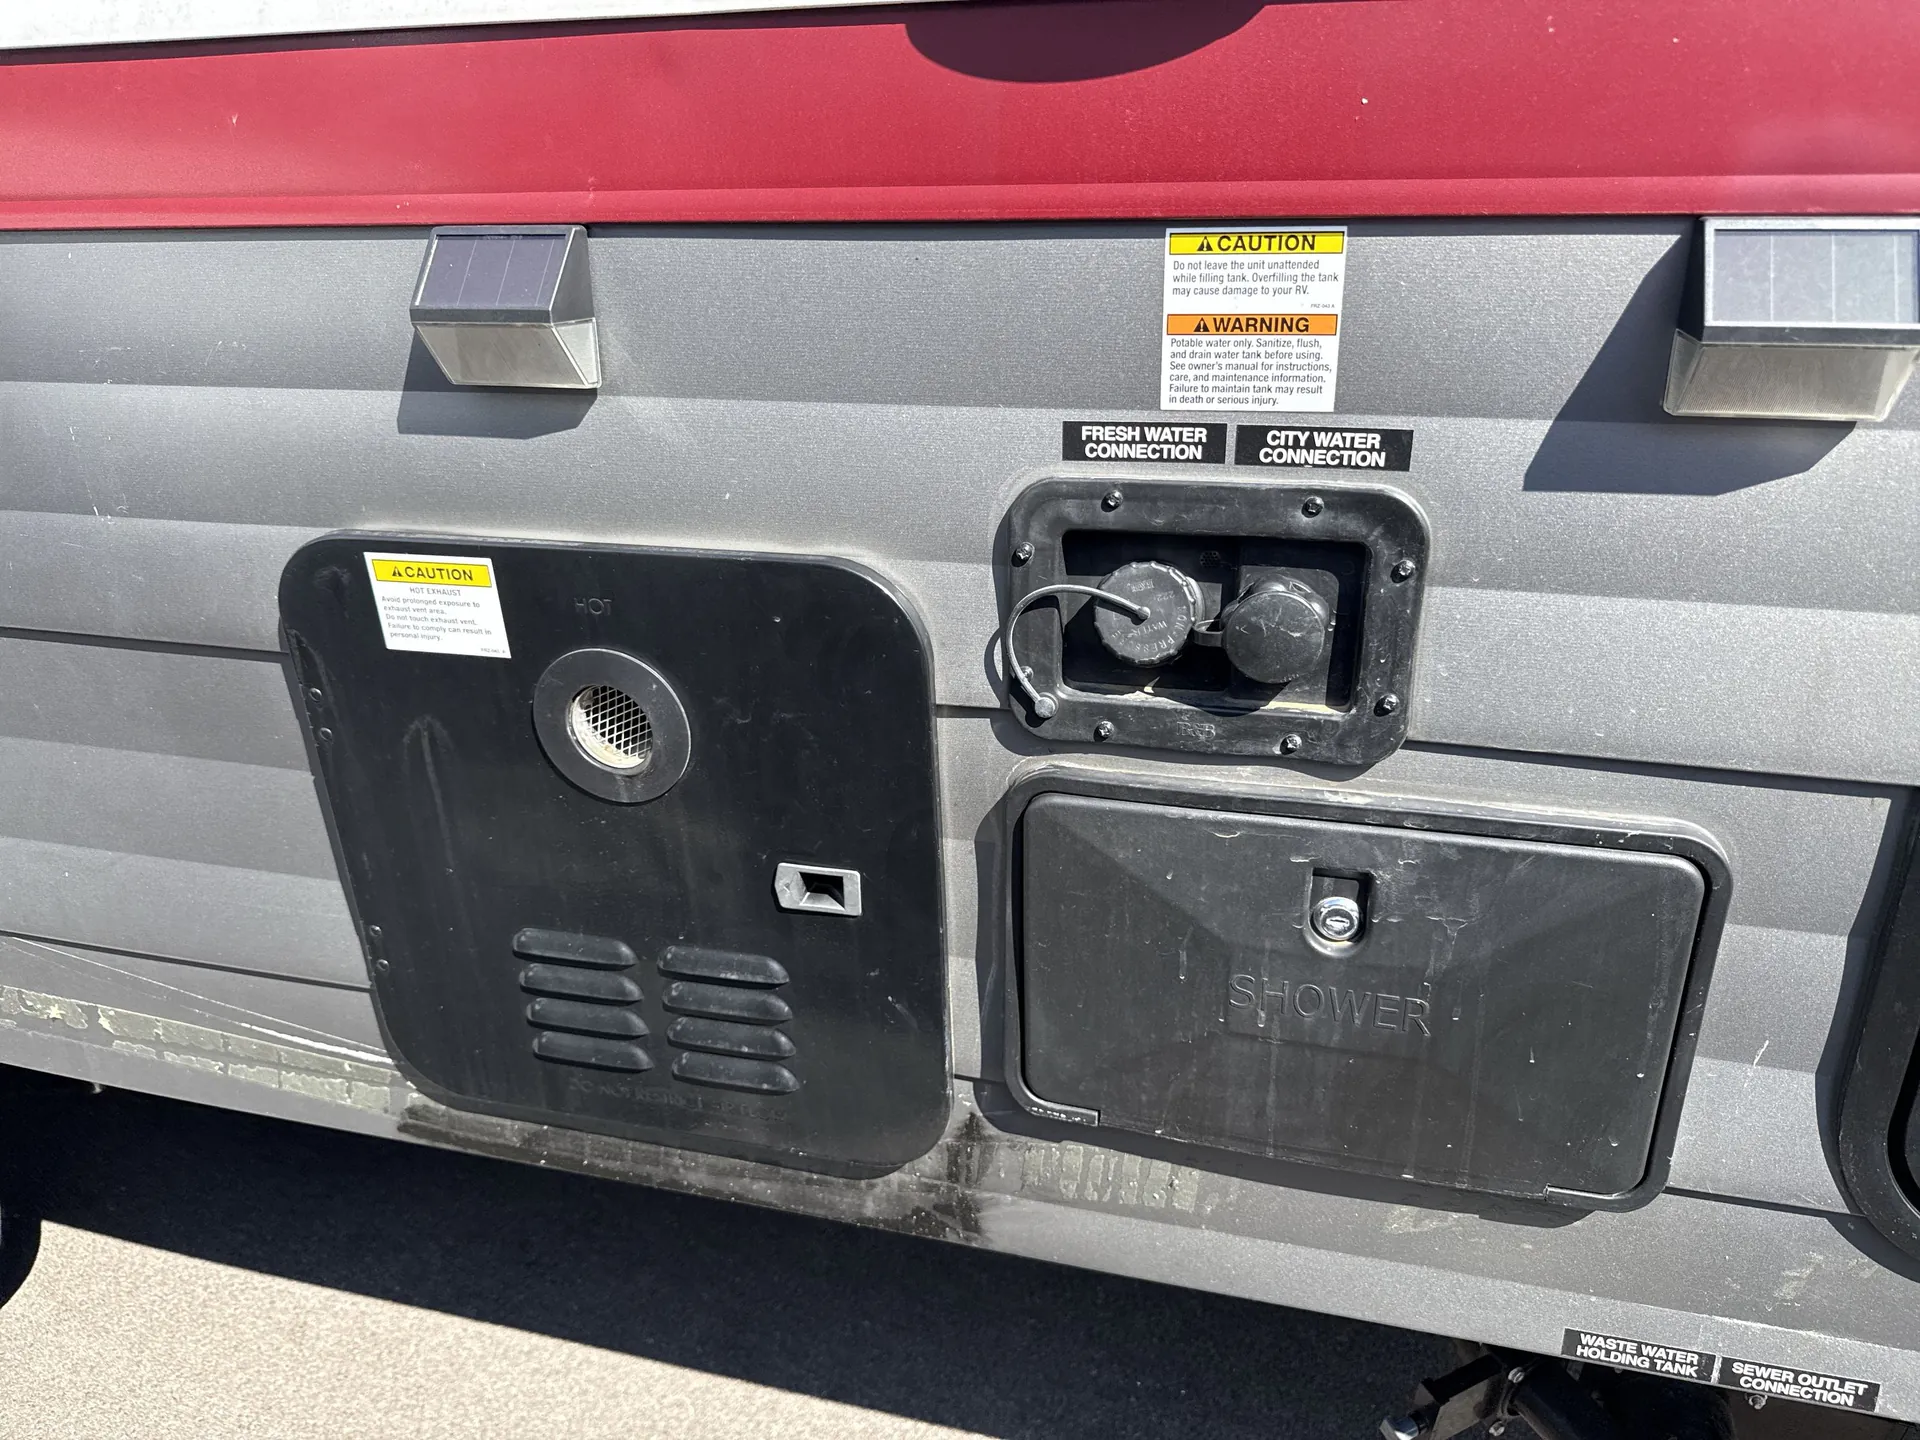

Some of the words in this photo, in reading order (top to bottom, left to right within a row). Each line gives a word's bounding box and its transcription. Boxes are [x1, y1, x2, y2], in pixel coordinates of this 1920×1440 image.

[1217, 234, 1316, 251] CAUTION
[1173, 261, 1185, 270] Do
[1187, 261, 1202, 270] not
[1204, 261, 1227, 270] leave
[1231, 260, 1243, 270] the
[1248, 260, 1265, 270] unit
[1268, 260, 1319, 270] unattended
[1173, 274, 1197, 283] while
[1199, 274, 1224, 284] filling
[1227, 273, 1249, 282] tank.
[1252, 273, 1297, 284] Overfilling
[1301, 273, 1315, 282] the
[1318, 272, 1338, 282] tank
[1172, 287, 1190, 297] may
[1193, 287, 1220, 295] cause
[1222, 286, 1258, 297] damage
[1261, 286, 1270, 295] to
[1272, 286, 1292, 296] your
[1295, 285, 1309, 295] RV.
[1213, 317, 1309, 333] WARNING
[1171, 338, 1203, 348] Potable
[1206, 339, 1231, 348] water
[1234, 339, 1254, 349] only.
[1256, 338, 1294, 349] Sanitize,
[1297, 338, 1322, 349] flush,
[1170, 350, 1187, 359] and
[1189, 350, 1211, 359] drain
[1214, 351, 1239, 359] water
[1242, 350, 1262, 359] tank
[1264, 350, 1293, 359] before
[1296, 351, 1323, 361] using.
[1170, 362, 1186, 370] See
[1188, 362, 1223, 370] owner's
[1225, 362, 1258, 371] manual
[1261, 362, 1273, 371] for
[1276, 362, 1332, 373] instructions,
[1169, 373, 1190, 383] care,
[1193, 373, 1209, 382] and
[1212, 373, 1269, 382] maintenance
[1271, 373, 1326, 383] information.
[1169, 384, 1198, 393] Failure
[1201, 385, 1209, 393] to
[1212, 384, 1250, 393] maintain
[1253, 385, 1272, 394] tank
[1275, 386, 1294, 395] may
[1296, 385, 1323, 394] result
[1169, 395, 1177, 403] in
[1179, 395, 1203, 404] death
[1206, 396, 1214, 404] or
[1217, 396, 1249, 404] serious
[1251, 396, 1278, 406] injury.
[1081, 426, 1140, 442] FRESH
[1145, 427, 1207, 443] WATER
[1266, 430, 1310, 447] CITY
[1312, 431, 1381, 449] WATER
[1084, 443, 1202, 460] CONNECTION
[1258, 447, 1386, 467] CONNECTION
[404, 566, 473, 581] CAUTION
[427, 588, 461, 596] EXHAUST
[402, 597, 437, 606] prolonged
[439, 600, 471, 608] exposure
[574, 598, 612, 616] HOT
[421, 625, 446, 633] comply
[421, 632, 443, 641] injury.
[1228, 974, 1431, 1037] SHOWER
[1579, 1333, 1638, 1354] WASTE
[1641, 1343, 1699, 1365] WATER
[1576, 1345, 1651, 1369] HOLDING
[1653, 1358, 1699, 1378] TANK
[1731, 1361, 1798, 1384] SEWER
[1798, 1374, 1868, 1397] OUTLET
[1739, 1376, 1854, 1406] CONNECTION
